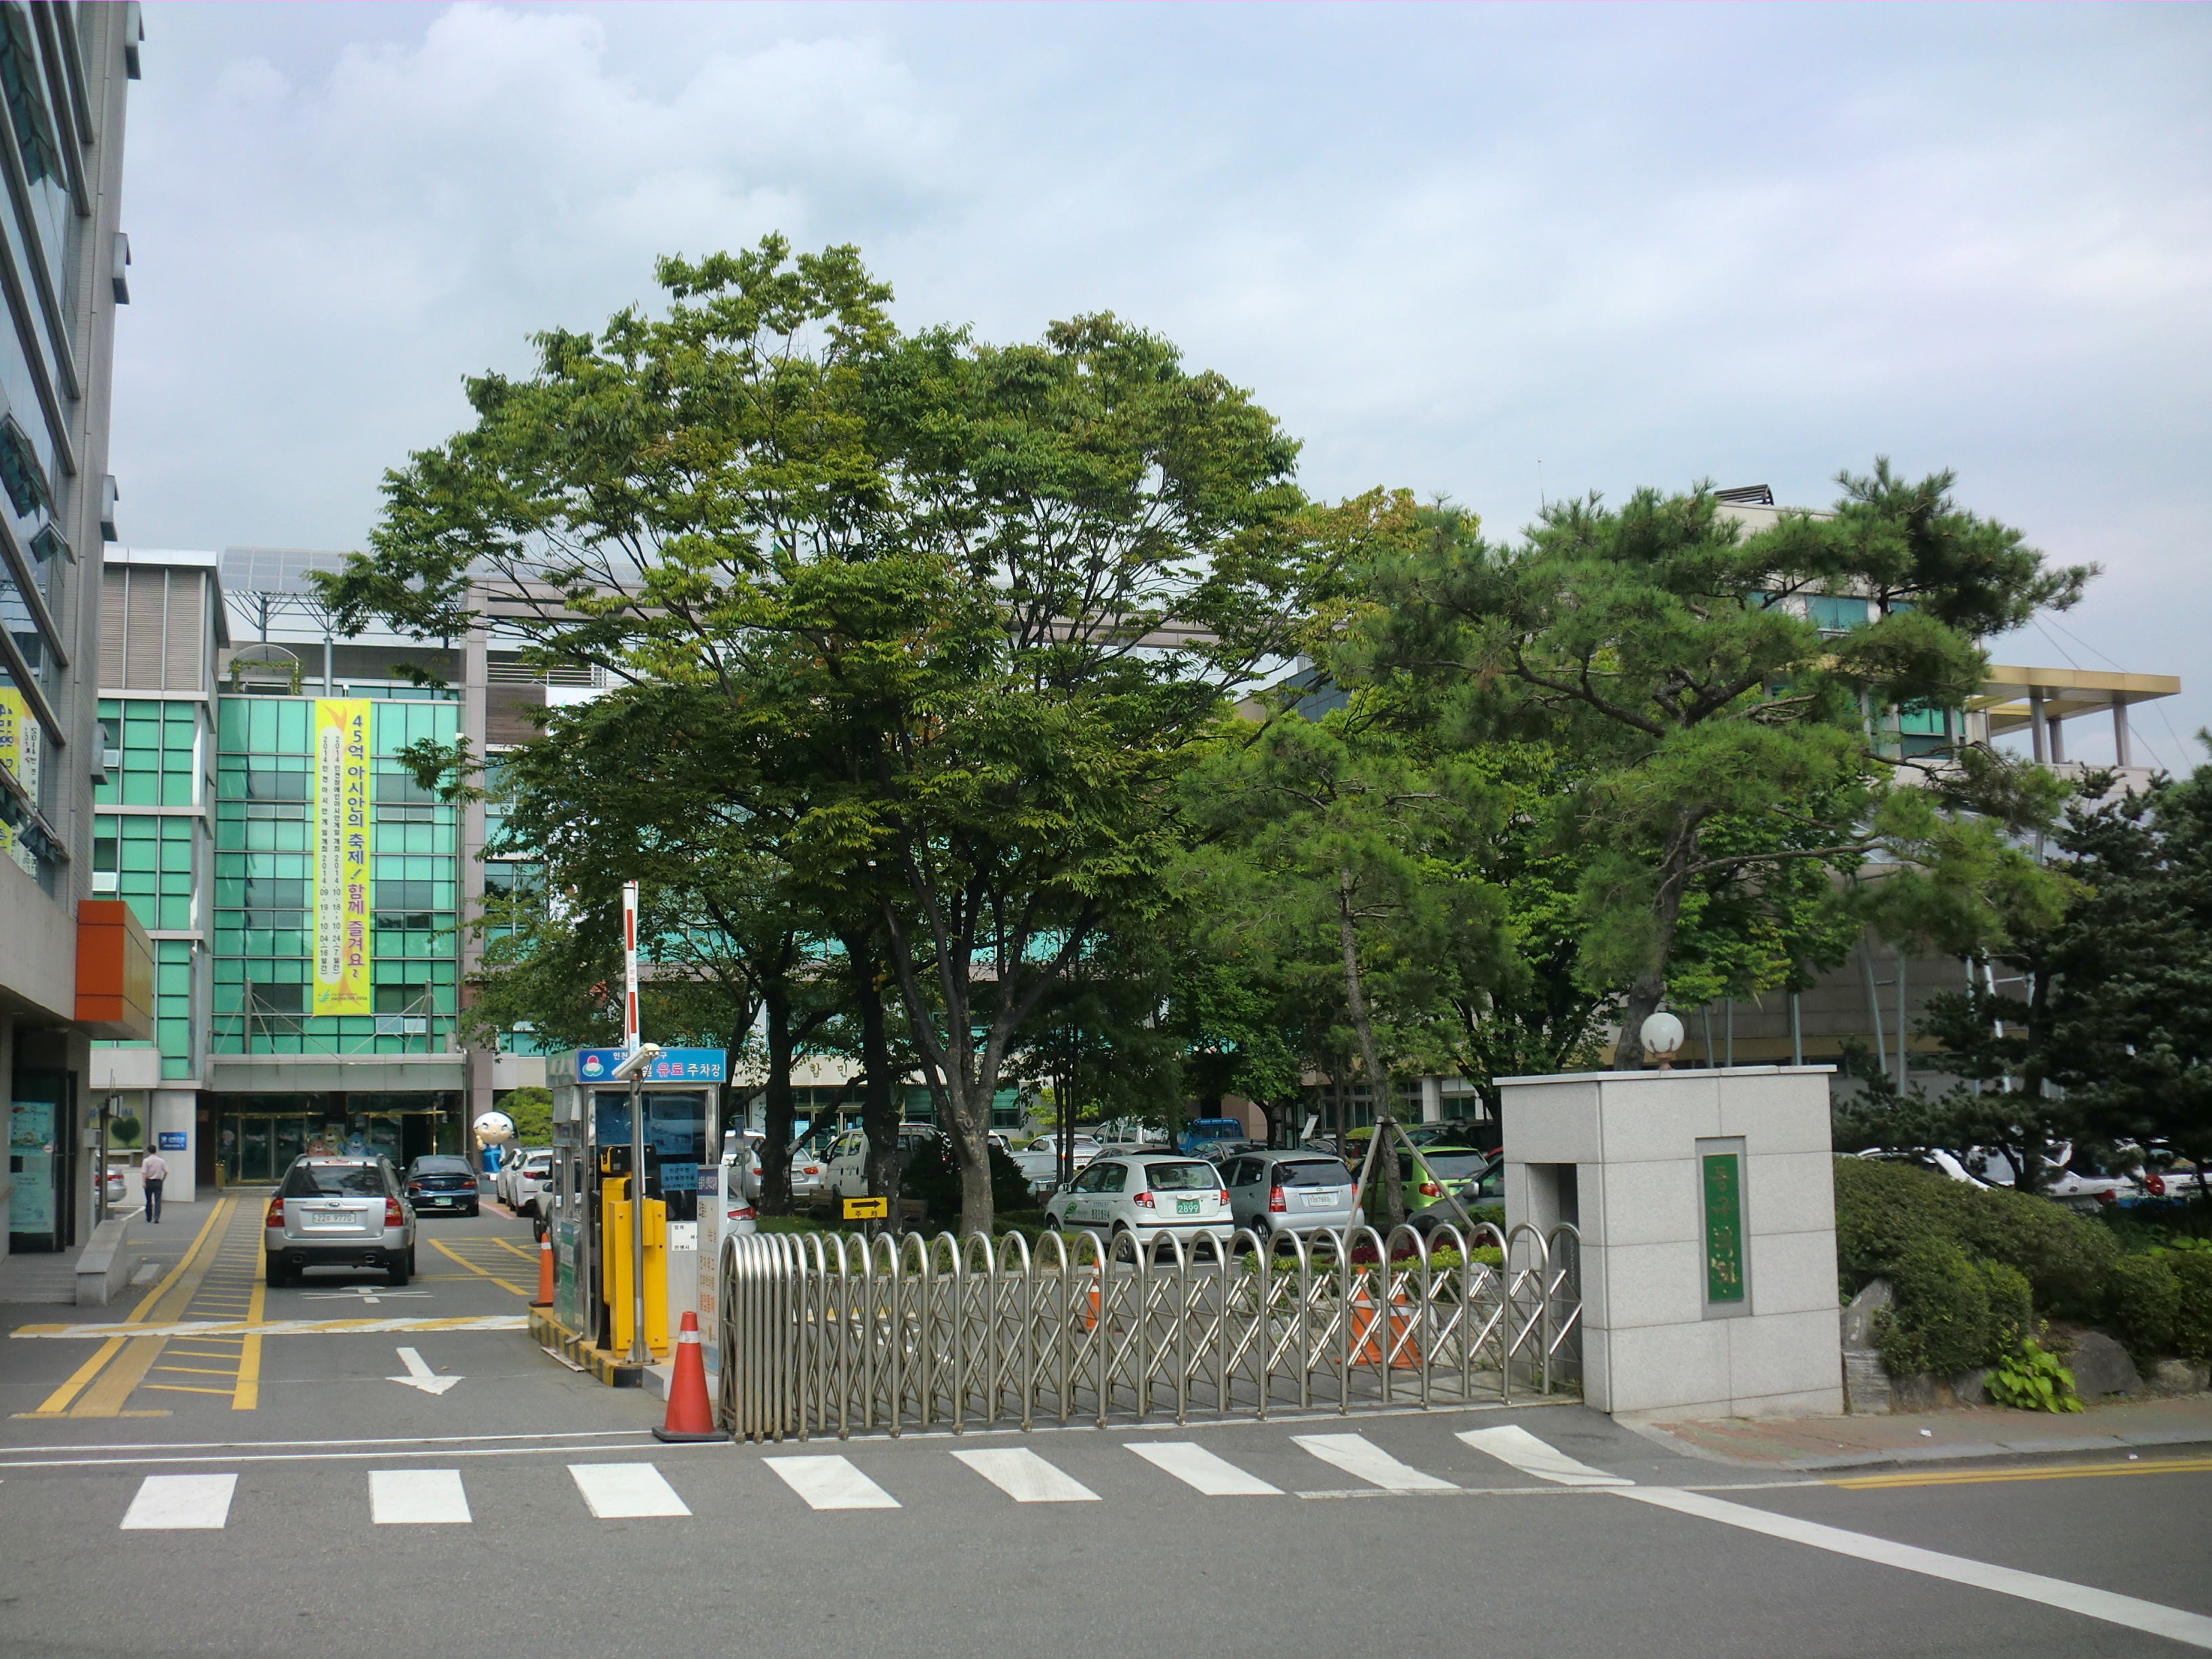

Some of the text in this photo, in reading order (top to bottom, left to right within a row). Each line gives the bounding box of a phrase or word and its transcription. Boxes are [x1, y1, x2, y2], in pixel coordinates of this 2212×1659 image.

[347, 714, 364, 760] 45억
[347, 765, 365, 827] 아시안의
[347, 833, 365, 880] 축제!
[347, 883, 366, 915] 함께
[656, 1062, 684, 1078] 유료
[687, 1063, 722, 1078] 주차장
[1178, 1205, 1199, 1213] 2899
